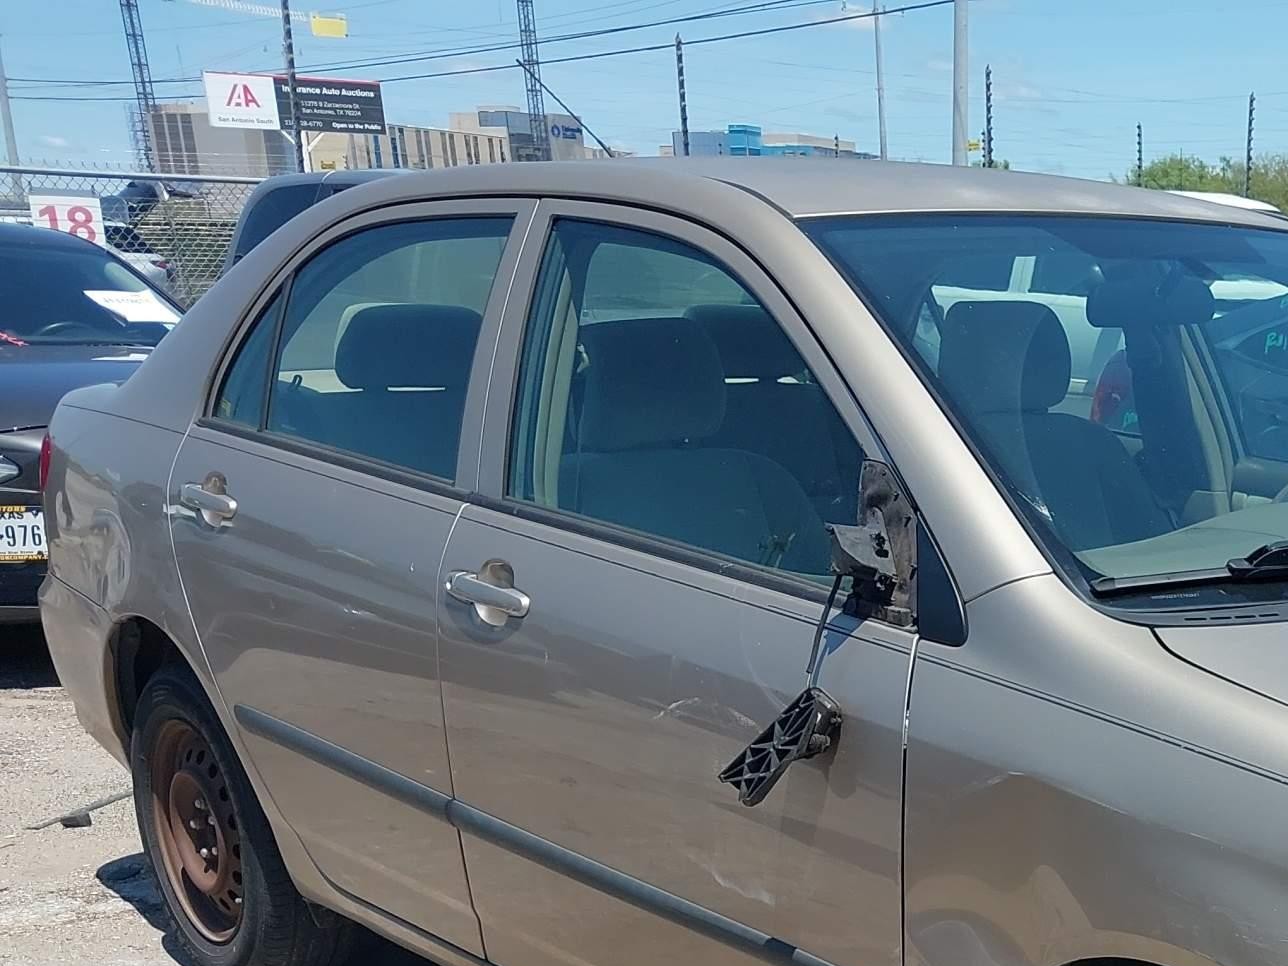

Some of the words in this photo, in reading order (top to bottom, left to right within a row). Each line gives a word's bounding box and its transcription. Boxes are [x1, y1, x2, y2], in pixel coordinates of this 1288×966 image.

[281, 84, 320, 94] Inurance
[322, 87, 340, 96] Auto
[341, 88, 375, 97] Auctions
[38, 205, 97, 242] 18
[5, 524, 42, 547] 976
